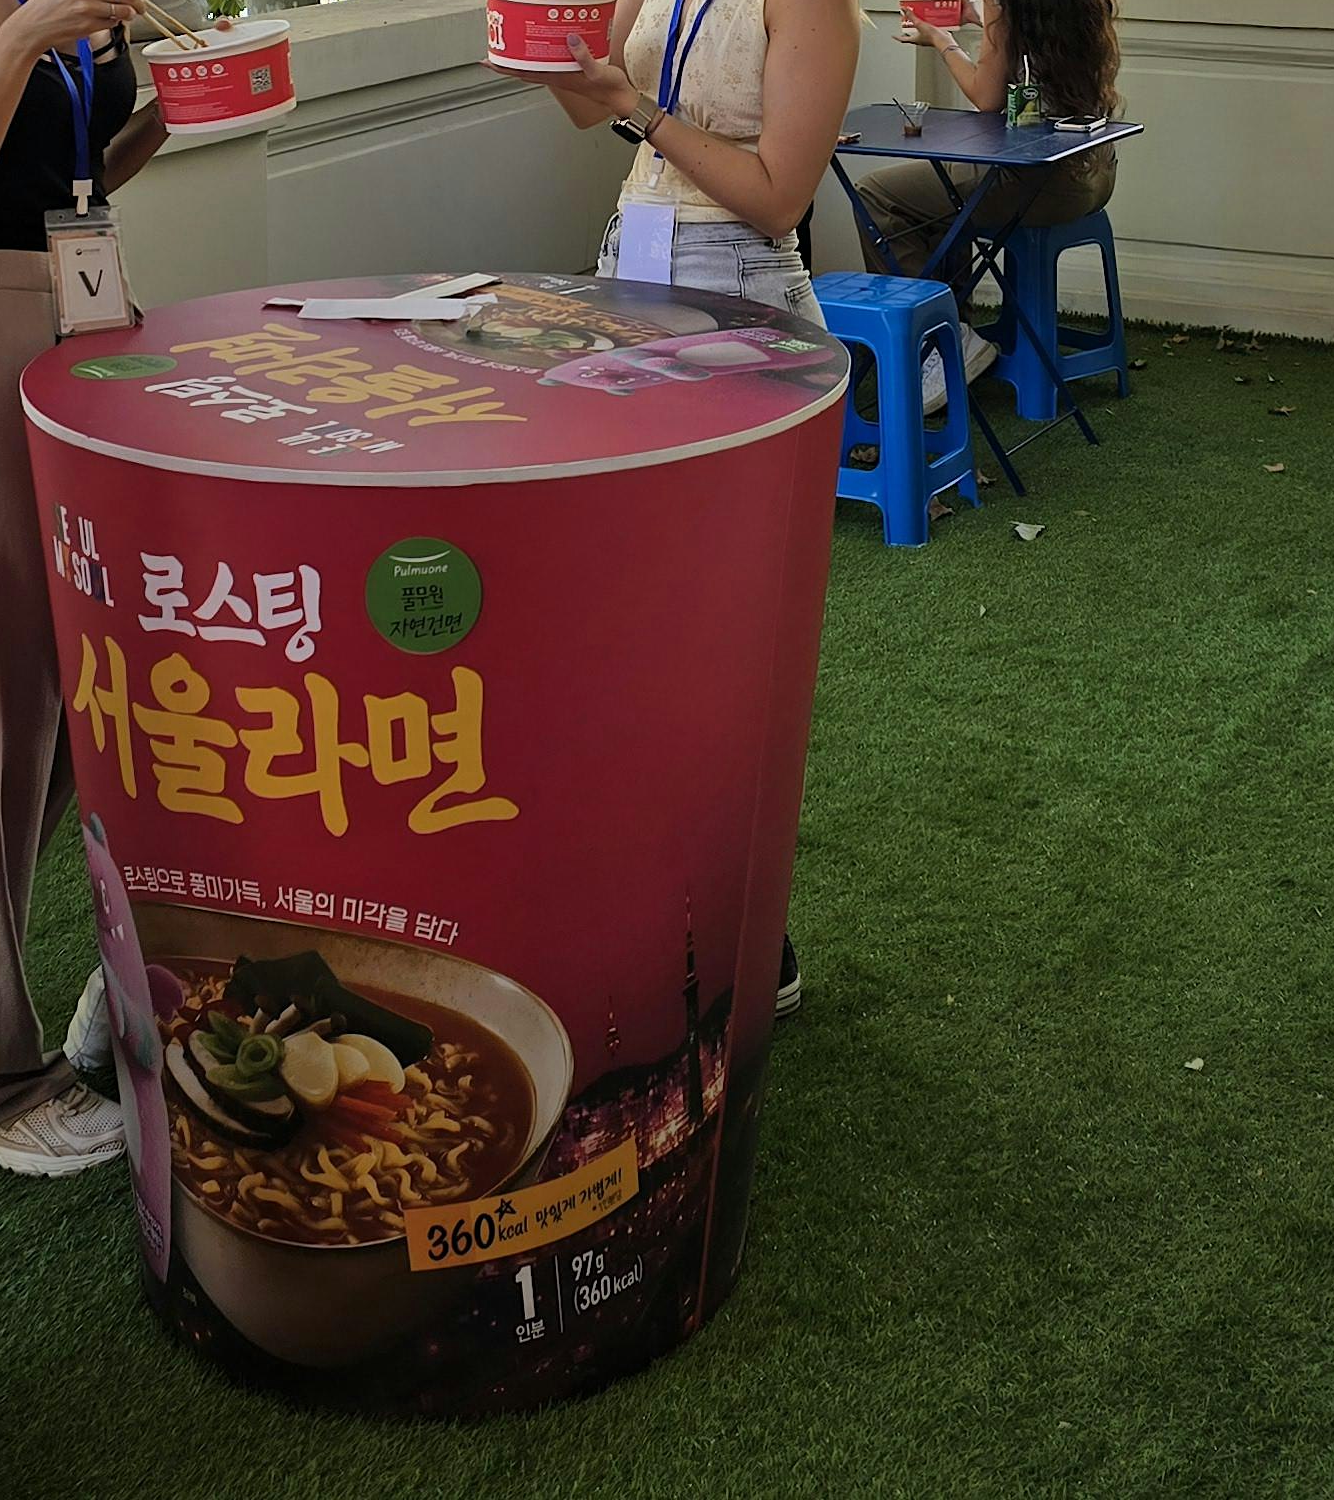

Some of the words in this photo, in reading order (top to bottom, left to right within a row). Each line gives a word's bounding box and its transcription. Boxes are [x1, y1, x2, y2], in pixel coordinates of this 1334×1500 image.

[78, 269, 103, 297] V
[170, 322, 528, 426] 서울라면
[144, 375, 318, 424] 로스팅
[394, 564, 448, 577] Pulmuone
[137, 551, 322, 663] 로스팅
[401, 584, 444, 612] 풀무원
[389, 612, 465, 638] 자연건면
[73, 633, 520, 837] 서울라면
[123, 865, 188, 896] 로스팅으로
[189, 871, 267, 909] 풍미가득,
[273, 886, 335, 919] 서울의
[341, 897, 409, 934] 미각을
[414, 912, 460, 946] 담다
[535, 1195, 576, 1229] 맛있게
[571, 1250, 605, 1281] 97g
[515, 1265, 536, 1320] 1
[516, 1319, 546, 1343] 인분
